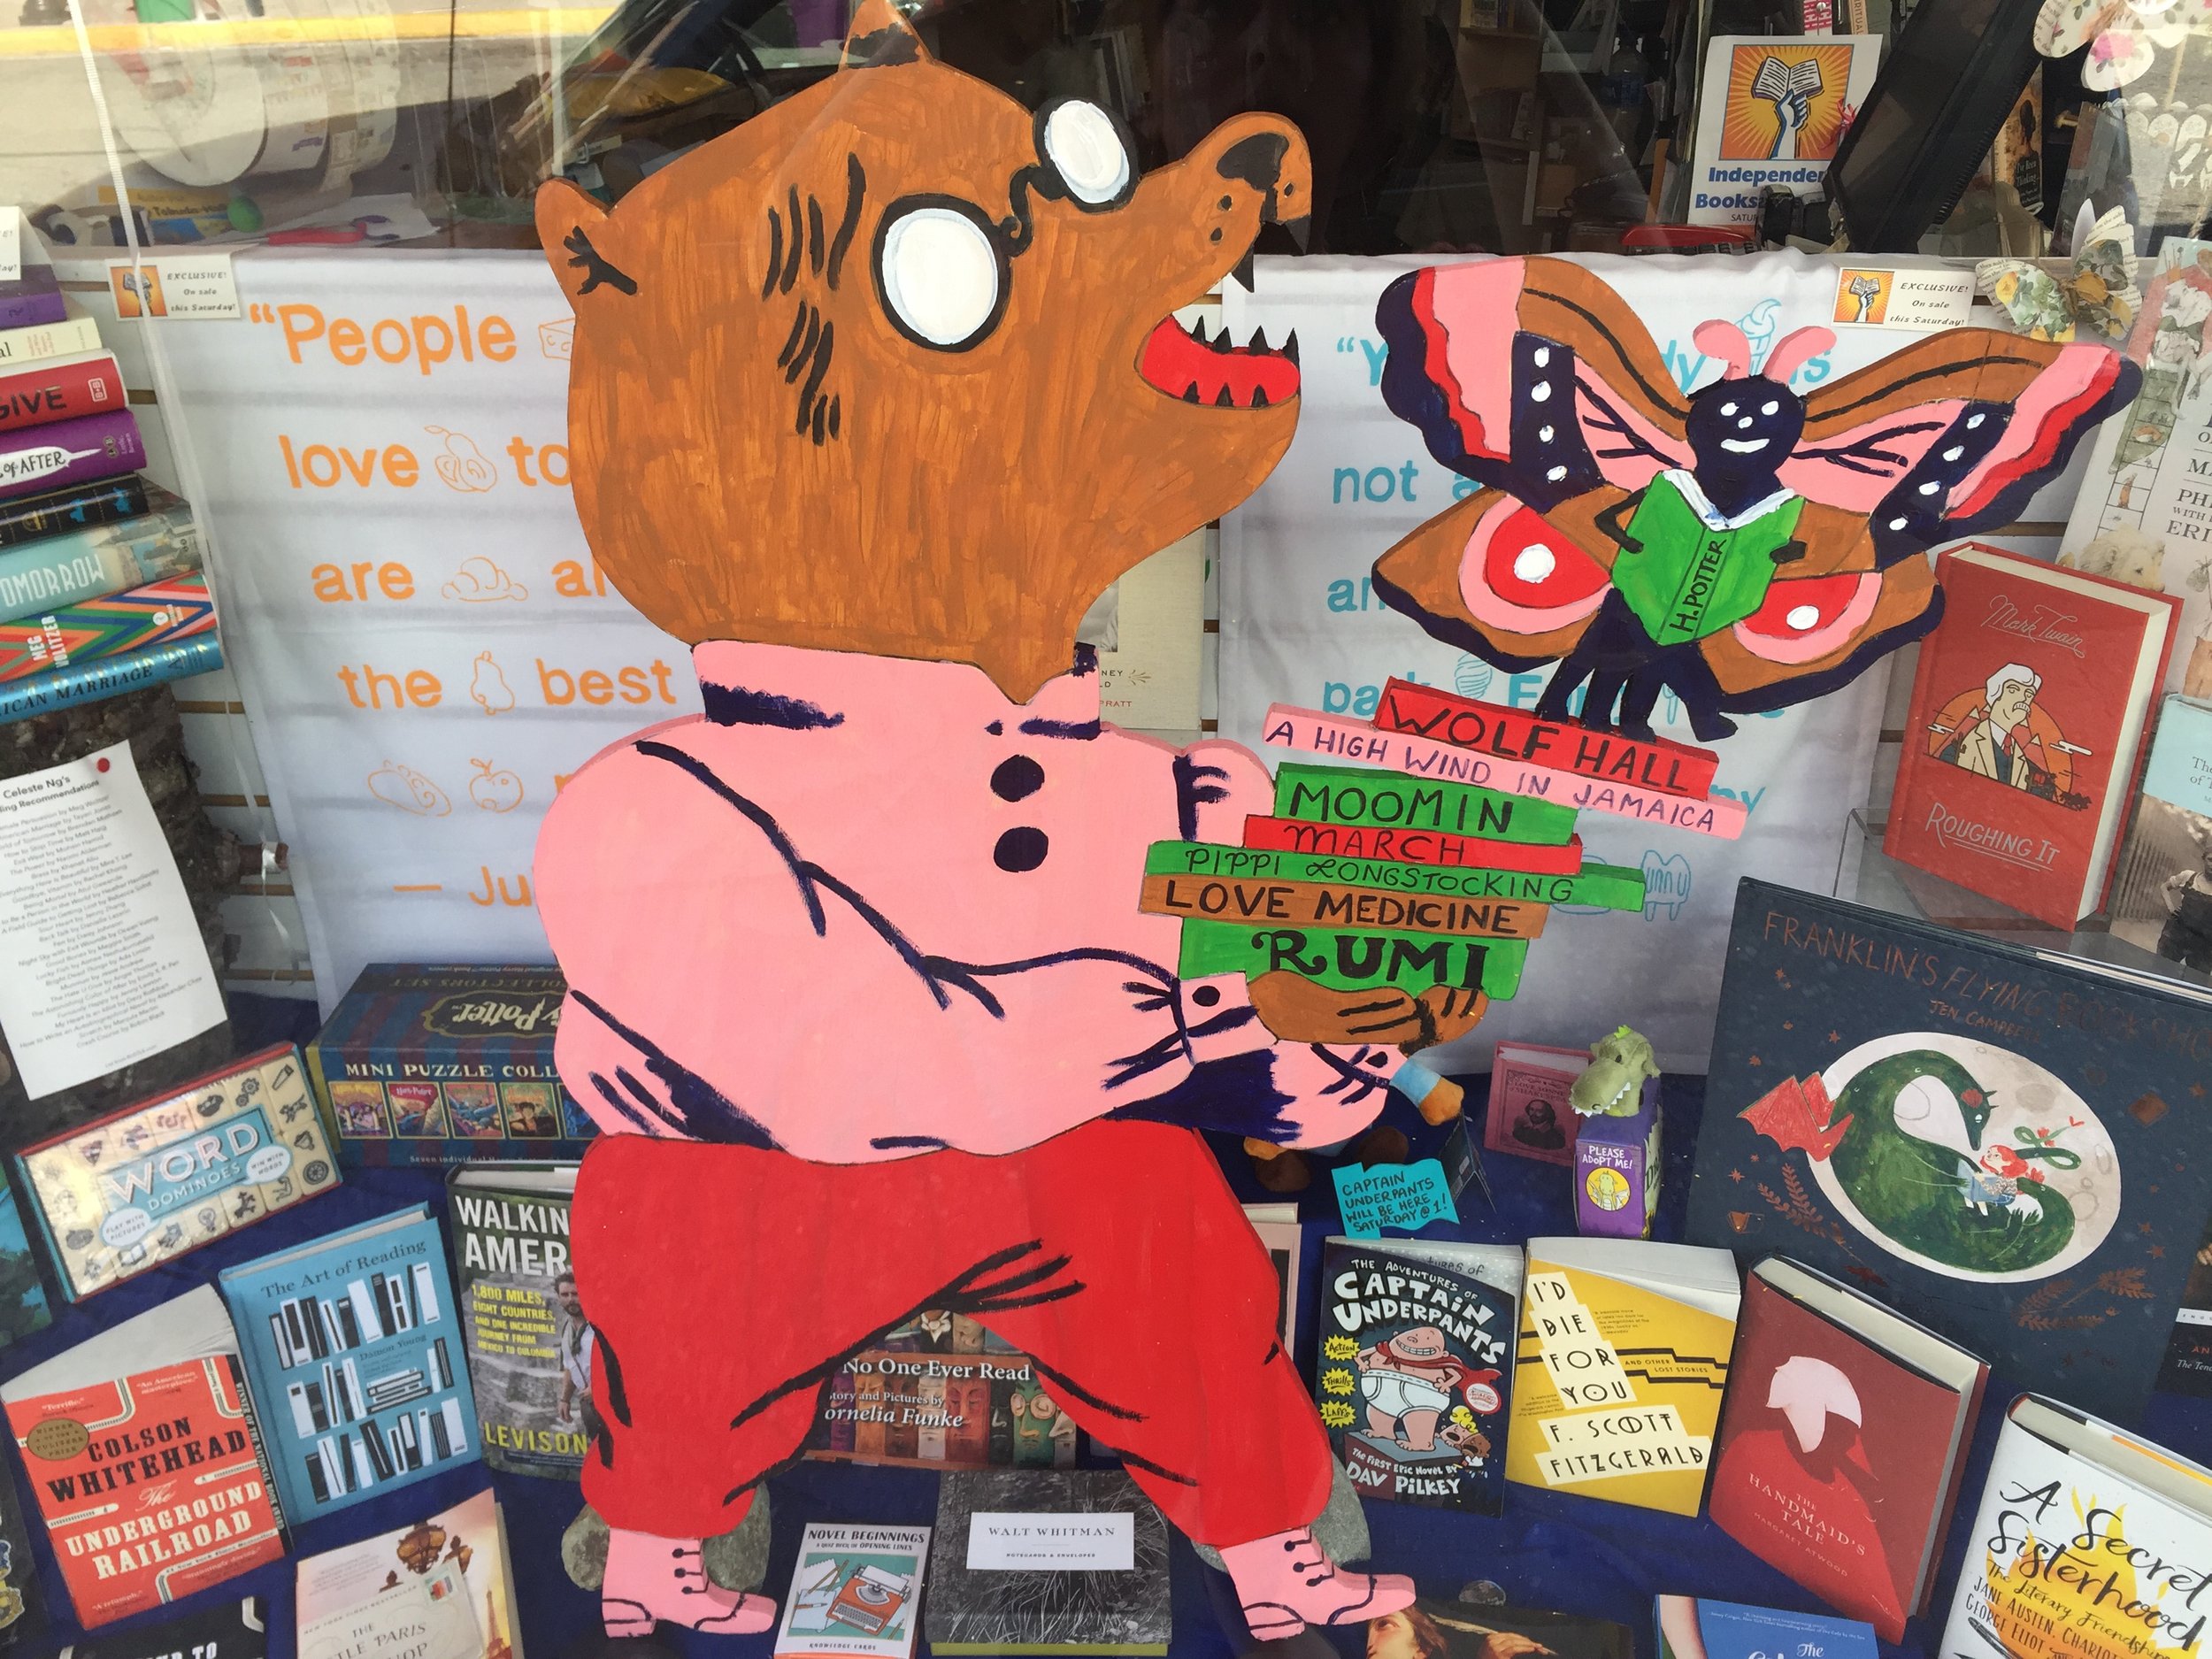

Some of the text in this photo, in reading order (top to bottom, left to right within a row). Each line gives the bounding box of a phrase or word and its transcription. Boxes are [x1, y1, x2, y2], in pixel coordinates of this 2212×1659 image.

[1901, 282, 1968, 292] EXCLUSIVE!
[1913, 316, 1964, 326] Saturday!
[20, 451, 65, 472] AFTER
[278, 435, 570, 489] love to
[1333, 459, 1417, 503] not
[2173, 507, 2205, 522] WITH
[311, 561, 415, 603] are
[1669, 537, 1727, 633] H.POTTER
[1981, 595, 2085, 658] Mark Twain
[27, 635, 48, 662] MEG
[42, 616, 69, 668] WOLITZER
[56, 666, 153, 702] MARRIAGE
[337, 658, 677, 710] the best
[1389, 694, 1689, 793] WOLF HALL
[3, 775, 70, 799] Celeste Ng's
[1267, 720, 1715, 833] A HIGH WIND IN JAMAICA
[2190, 775, 2206, 785] of
[19, 780, 99, 808] Recommendations
[1289, 781, 1513, 833] MOOMIN
[1283, 825, 1465, 864] MARCH
[1185, 848, 1574, 903] PIPPI LONGSTOCKING
[1165, 879, 1521, 934] LOVE MEDICINE
[1252, 930, 1490, 992] RUMI
[1763, 910, 2052, 1018] FRANKLIN'S FLYING
[1930, 999, 1960, 1019] JEN
[346, 1064, 495, 1078] MINI PUZZLE
[112, 1123, 259, 1203] WORD
[252, 1153, 284, 1170] WIN WITH
[1582, 1153, 1632, 1169] ADOPT ME!
[1589, 1146, 1624, 1159] PLEASE
[148, 1163, 241, 1210] DOMINOES
[1342, 1171, 1405, 1196] CAPTAIN
[1345, 1178, 1434, 1206] UNDERPANTS
[1347, 1194, 1430, 1222] WILL BE HERE
[1353, 1206, 1430, 1232] SATURDAY @
[106, 1223, 123, 1234] PLAY
[111, 1222, 146, 1240] PICTURES
[260, 1240, 426, 1298] The Art of Reading
[1351, 1259, 1479, 1301] THE ADVENTURES OF
[472, 1284, 546, 1307] 1,800 MILES,
[1533, 1281, 1565, 1302] I'D
[473, 1301, 556, 1322] EIGHT COUNTRIES,
[475, 1316, 556, 1334] AND ONE INCREDIBLE
[1542, 1314, 1586, 1337] DIE
[477, 1329, 536, 1345] JOURNEY FROM
[1333, 1300, 1507, 1364] UNDERPANTS
[359, 1344, 395, 1362] Damon
[397, 1333, 426, 1349] Young
[477, 1340, 556, 1358] MEXICO TO COLOMBIA
[1549, 1348, 1615, 1371] FOR
[843, 1358, 1031, 1381] No One Ever Read
[2177, 1359, 2192, 1369] The
[858, 1390, 945, 1408] and Pictures by
[1561, 1381, 1627, 1404] YOU
[902, 1407, 964, 1428] Funke
[1549, 1414, 1671, 1442] F. SCOTT
[88, 1417, 191, 1463] COLSON
[483, 1422, 588, 1455] LEVISON
[47, 1430, 245, 1502] WHITEHEAD
[236, 1382, 284, 1531] WINNER OF THE NATIONAL BOOK AWARD
[1353, 1448, 1365, 1460] The
[1550, 1447, 1703, 1478] FITZGERALD
[1347, 1461, 1387, 1486] DAV
[135, 1479, 177, 1512] The
[1796, 1492, 1816, 1510] THE
[65, 1481, 262, 1557] UNDERGROUND
[1748, 1472, 1866, 1556] HANDMAID'S
[1782, 1510, 1825, 1546] TALE
[92, 1509, 251, 1579] RAILROAD
[808, 1530, 925, 1543] NOVEL BEGINNINGS
[988, 1526, 1116, 1537] WALT WHITMAN
[1753, 1512, 1848, 1578] MARGARET ATWOOD
[2000, 1480, 2212, 1610] A Secret
[1987, 1510, 2207, 1651] Sisterhood
[1987, 1558, 2072, 1621] The Literary
[304, 1586, 417, 1634] NEW YORK TIMES BESTSELLER
[1974, 1577, 2055, 1639] JANE AUSTEN,
[353, 1623, 373, 1637] THE
[374, 1623, 426, 1647] PARIS
[1965, 1594, 2046, 1654] GEORGE ELIOT
[191, 1642, 217, 1659] TO
[1797, 1642, 1824, 1657] The
